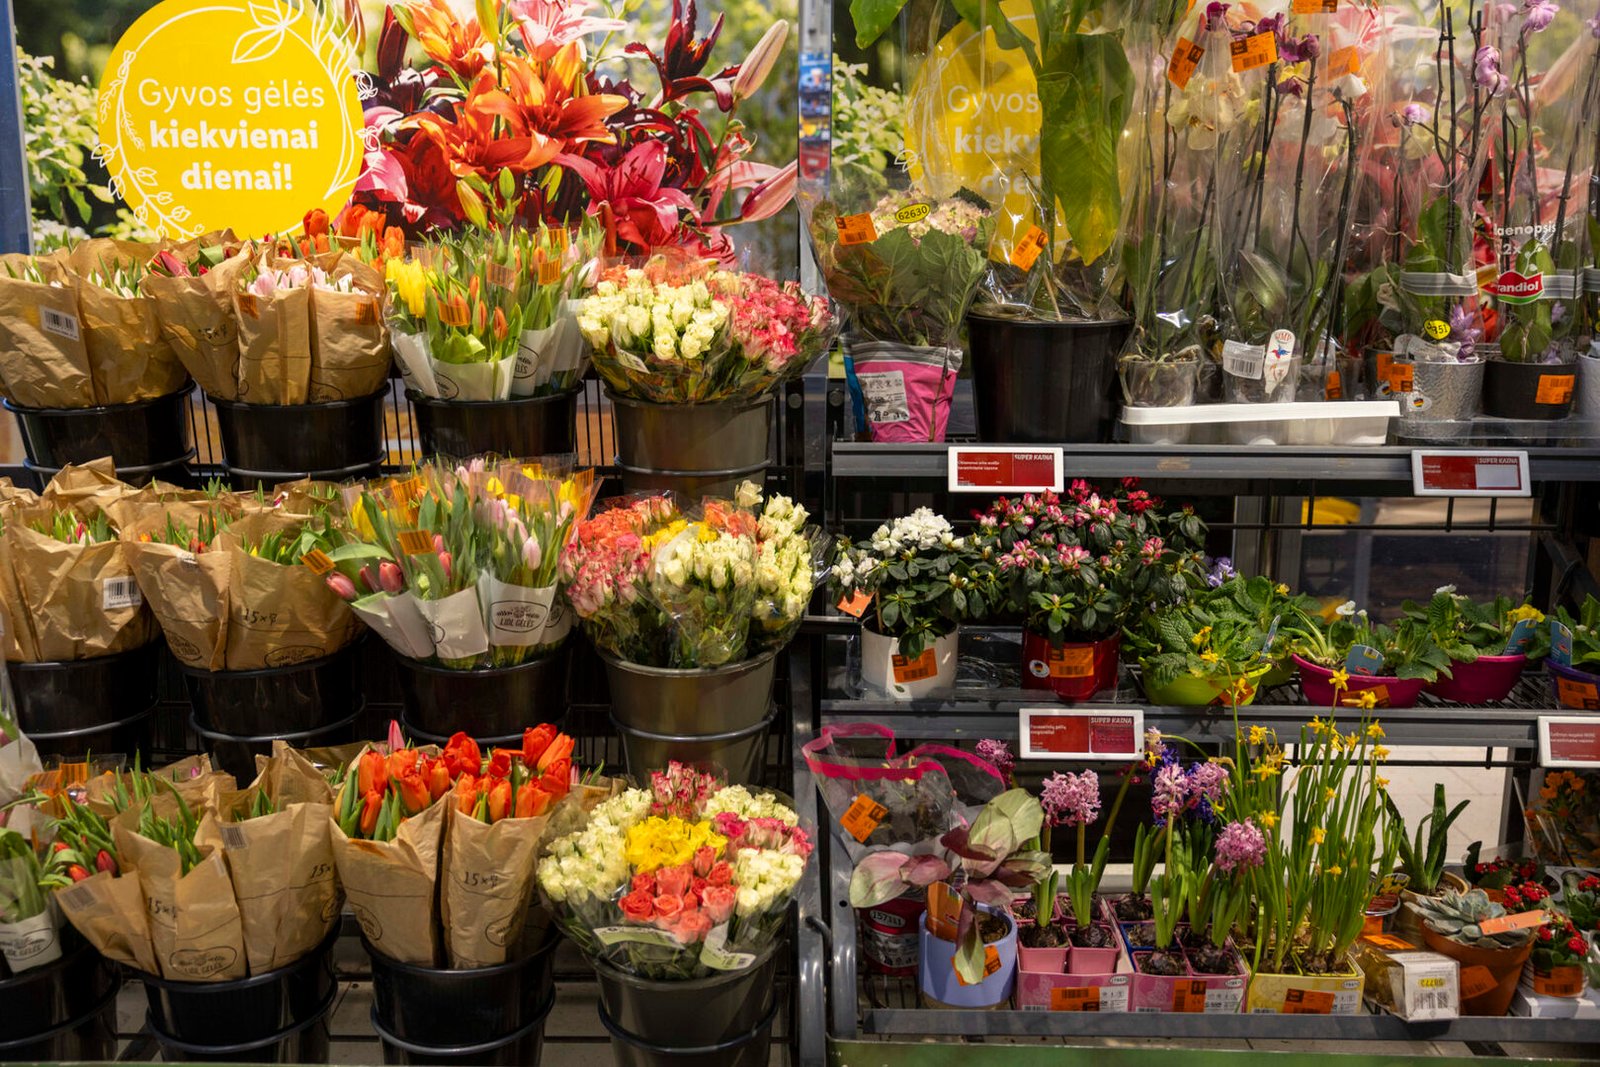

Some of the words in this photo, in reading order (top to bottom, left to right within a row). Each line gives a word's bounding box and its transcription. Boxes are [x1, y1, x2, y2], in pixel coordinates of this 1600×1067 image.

[138, 78, 232, 115] Gyvos
[243, 78, 325, 114] gėlės
[948, 86, 1039, 119] Gyvos
[150, 119, 318, 150] kiekvienai
[181, 161, 293, 191] dienai!
[898, 205, 928, 221] 62630
